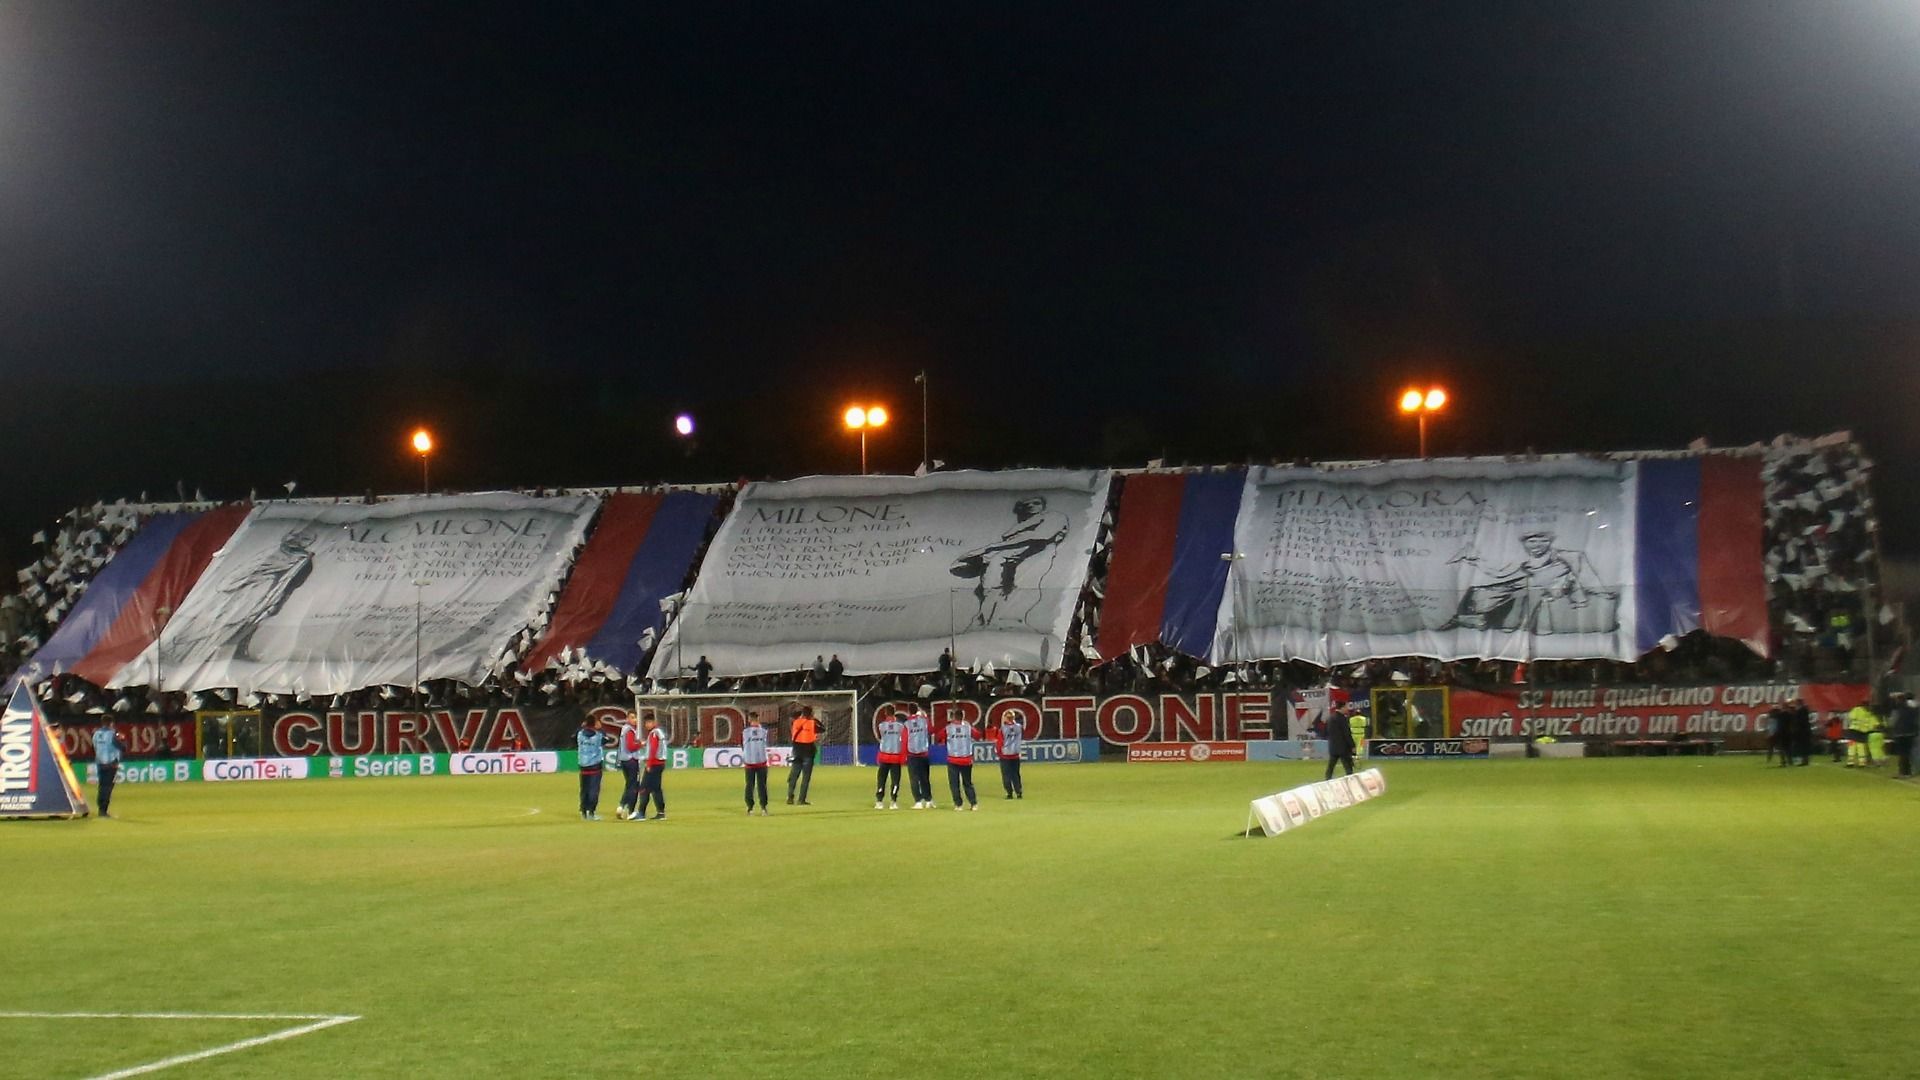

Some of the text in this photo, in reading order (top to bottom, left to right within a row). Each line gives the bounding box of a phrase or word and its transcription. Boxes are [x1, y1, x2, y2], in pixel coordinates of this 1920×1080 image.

[1517, 680, 1801, 711] se mai qualcuno capirà
[272, 692, 1273, 757] CURVA SUD CROTONE
[1460, 711, 1513, 738] sarà
[1519, 711, 1641, 738] senz'altro
[1648, 712, 1679, 734] un
[1685, 711, 1748, 734] altro
[0, 709, 33, 794] TRONY
[1130, 747, 1187, 760] expert
[1403, 742, 1425, 755] COS
[113, 760, 191, 784] Serie B
[214, 760, 293, 780] ConTe.it
[353, 753, 435, 777] Serie B
[460, 753, 542, 774] ConTe.it
